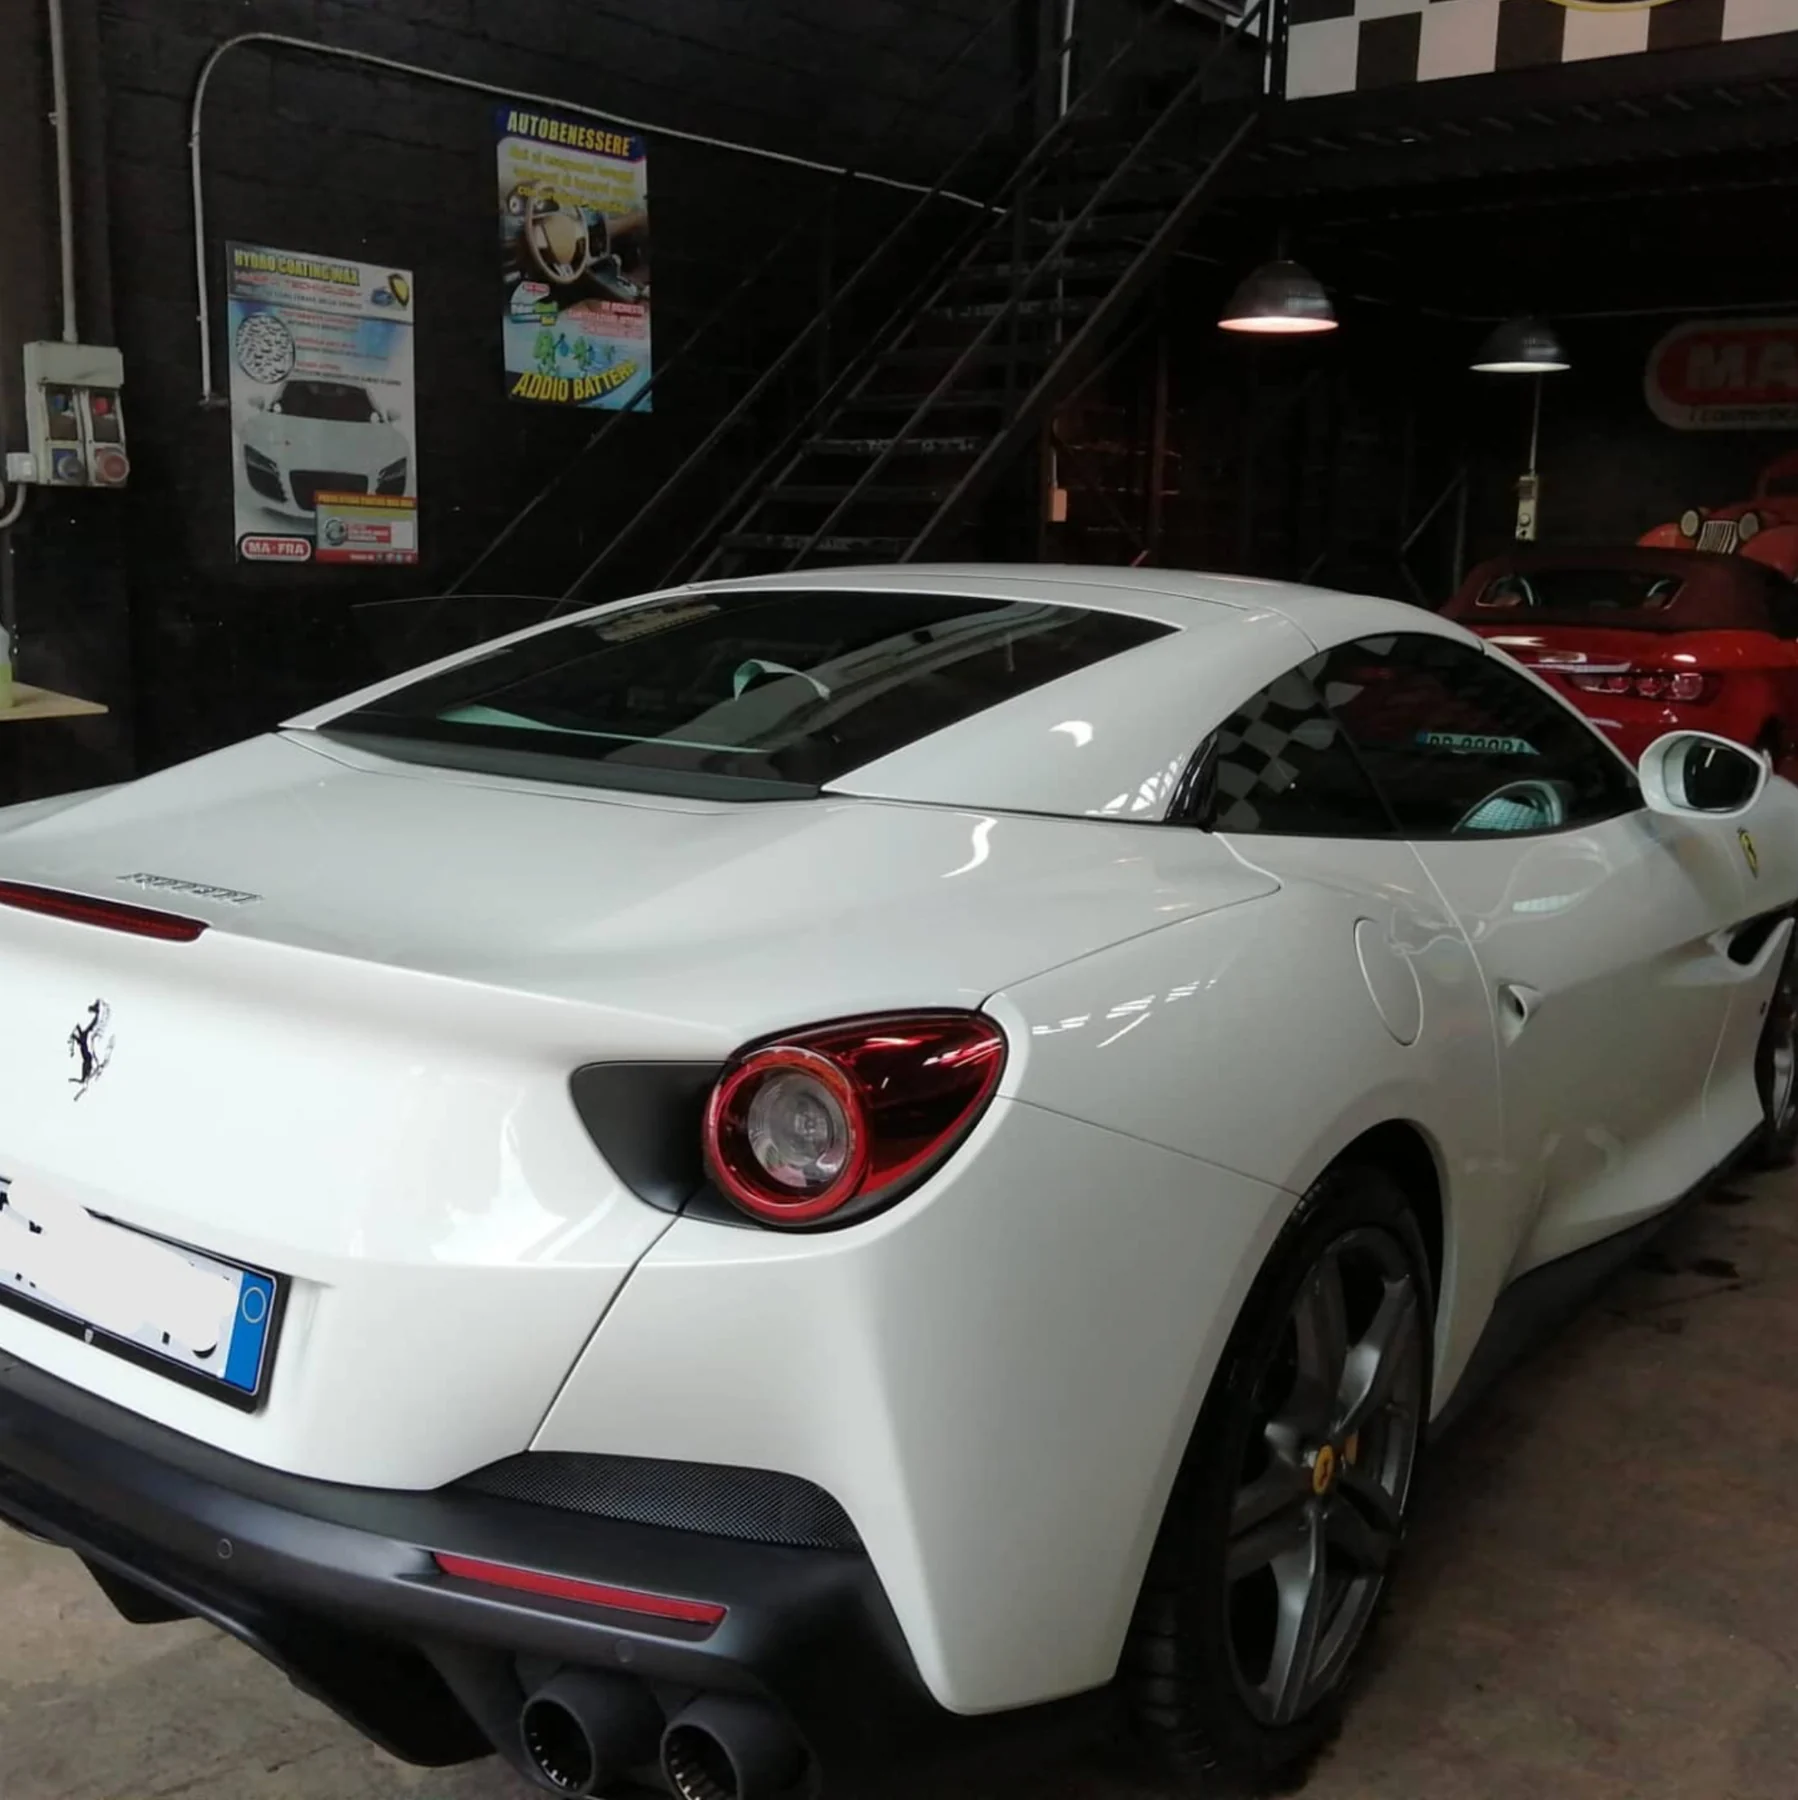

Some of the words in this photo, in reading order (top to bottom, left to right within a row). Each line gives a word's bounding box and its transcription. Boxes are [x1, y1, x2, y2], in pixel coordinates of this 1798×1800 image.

[507, 111, 631, 156] AUTOBENESSERE
[234, 249, 276, 271] HYDRO
[511, 372, 568, 402] ADDIO
